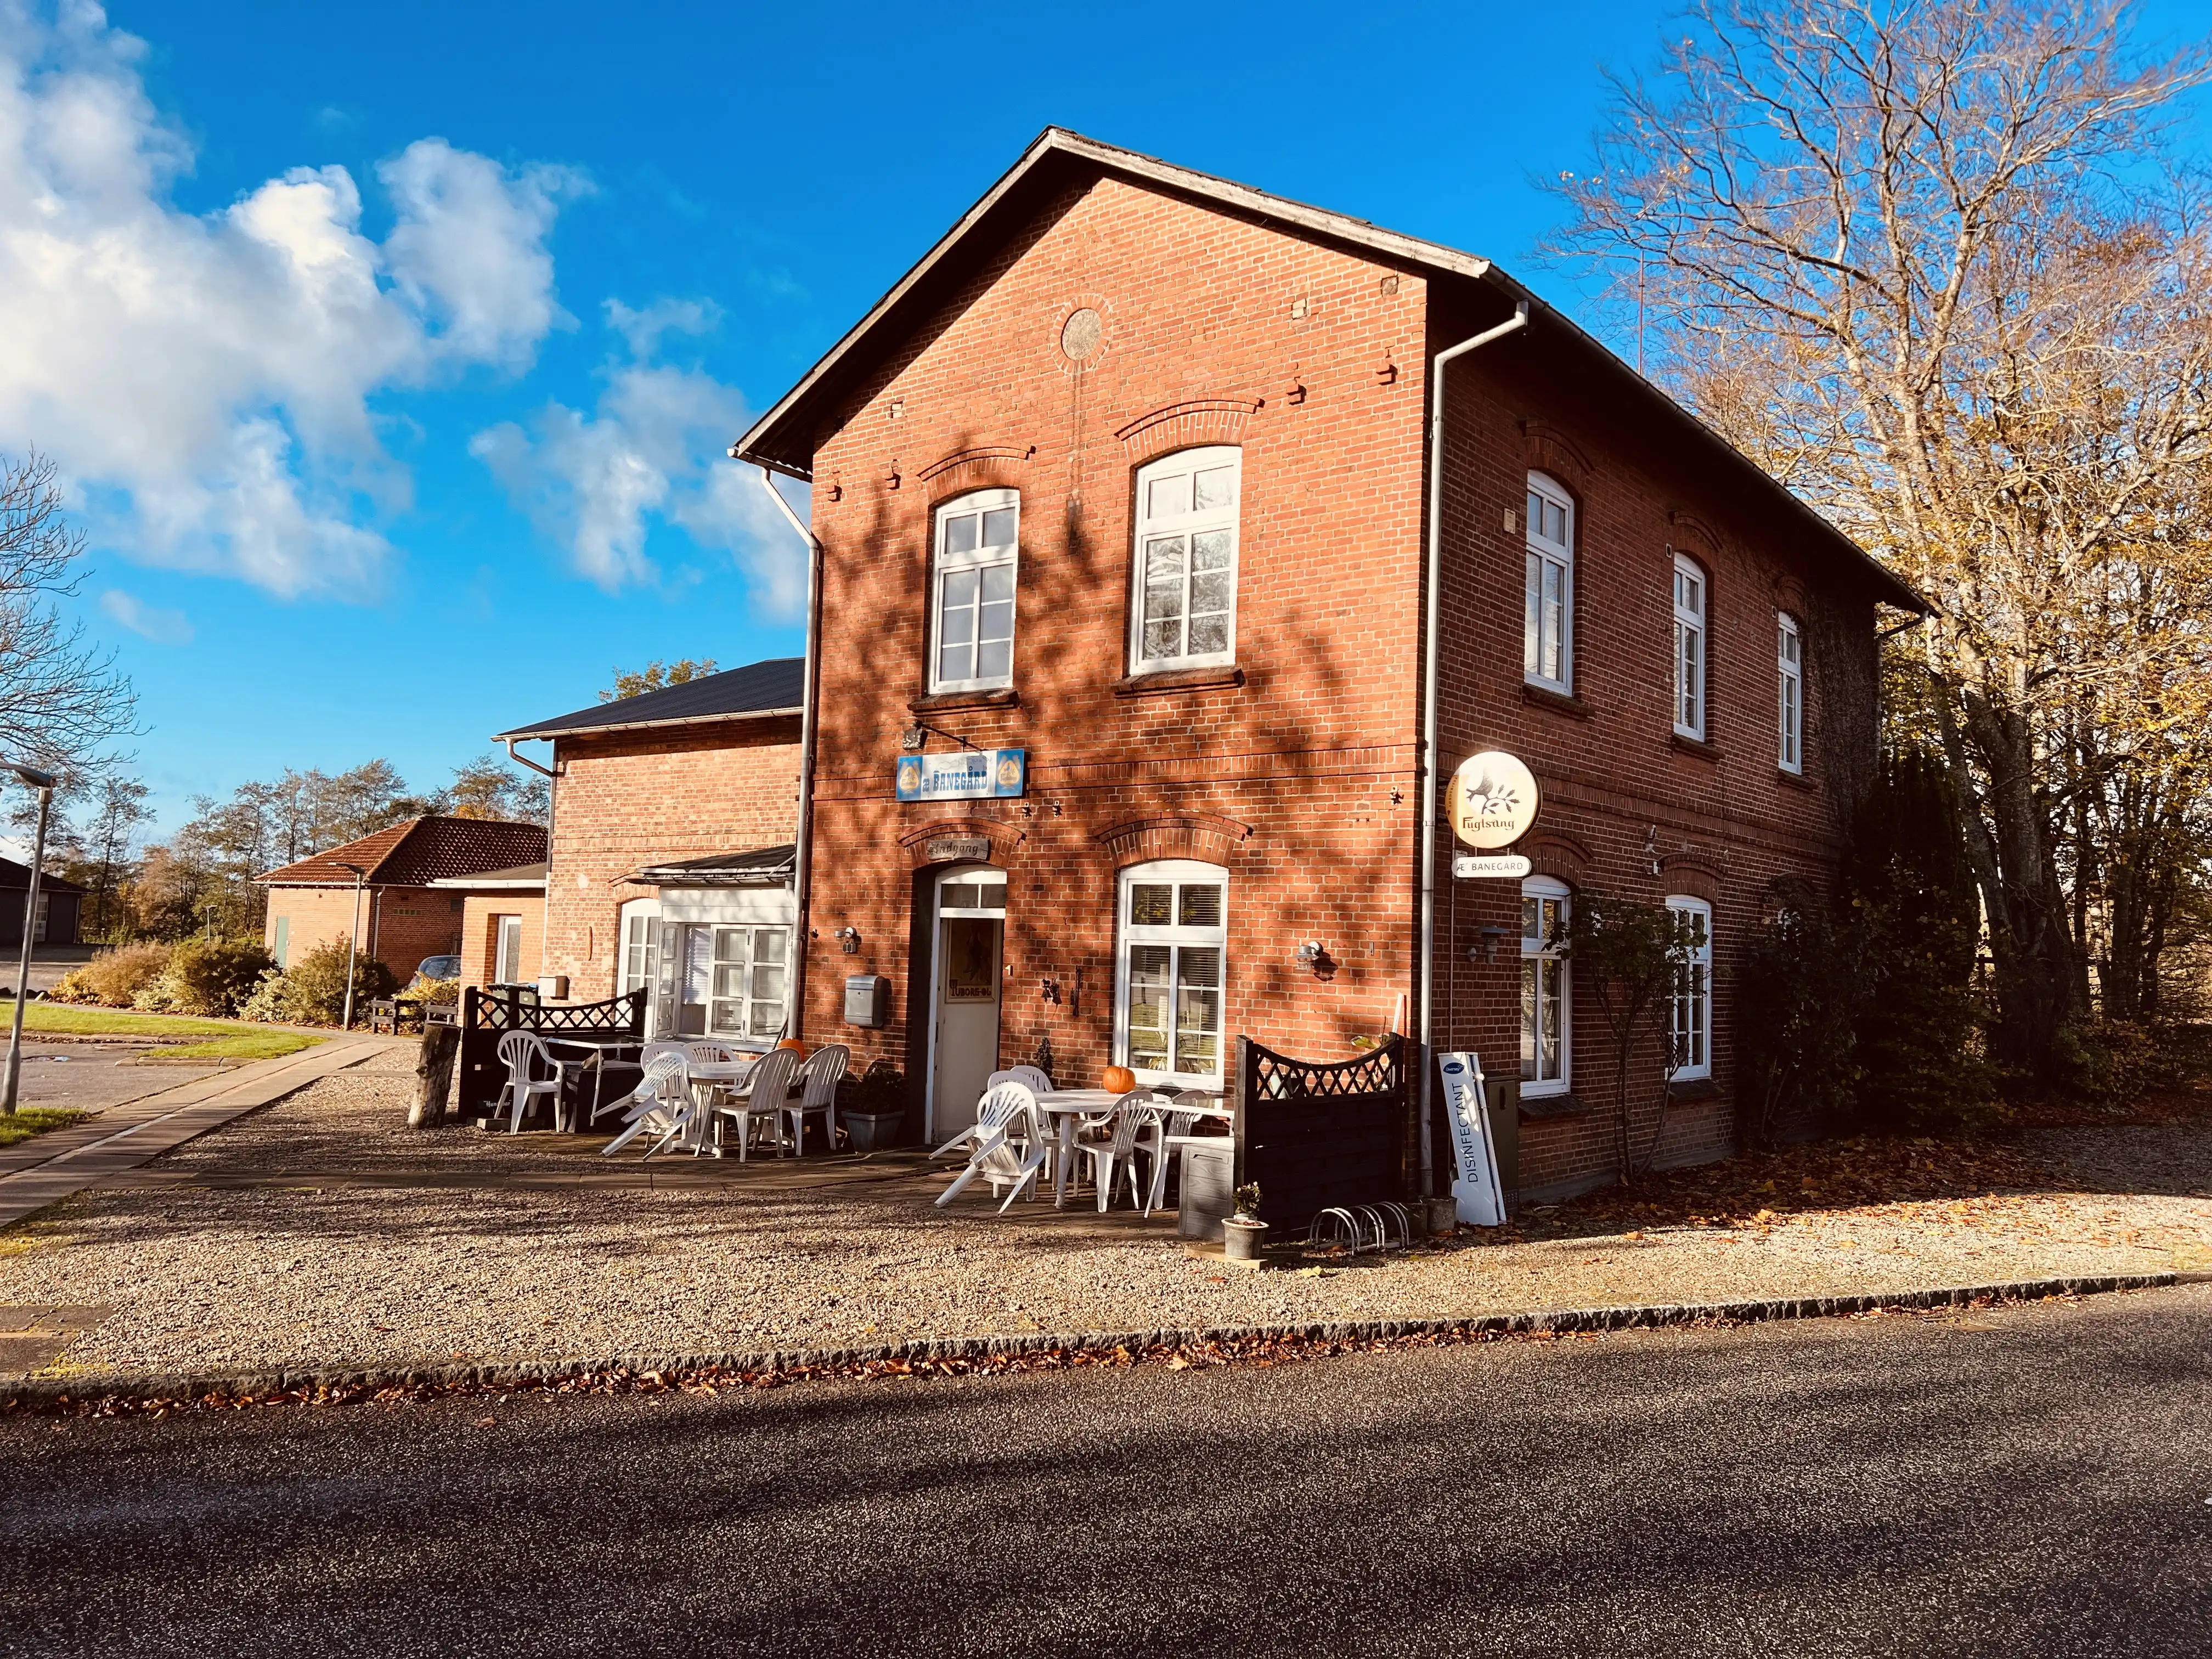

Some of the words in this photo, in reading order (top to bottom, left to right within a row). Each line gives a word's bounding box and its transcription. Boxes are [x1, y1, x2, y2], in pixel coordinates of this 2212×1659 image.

[933, 766, 988, 791] BANEGÅRD
[1463, 816, 1515, 832] Fuglsang
[935, 842, 978, 856] Indgang
[1471, 860, 1523, 871] BANEGÅRD
[1005, 964, 1011, 976] 1
[1452, 1082, 1479, 1183] DISINFECTANT
